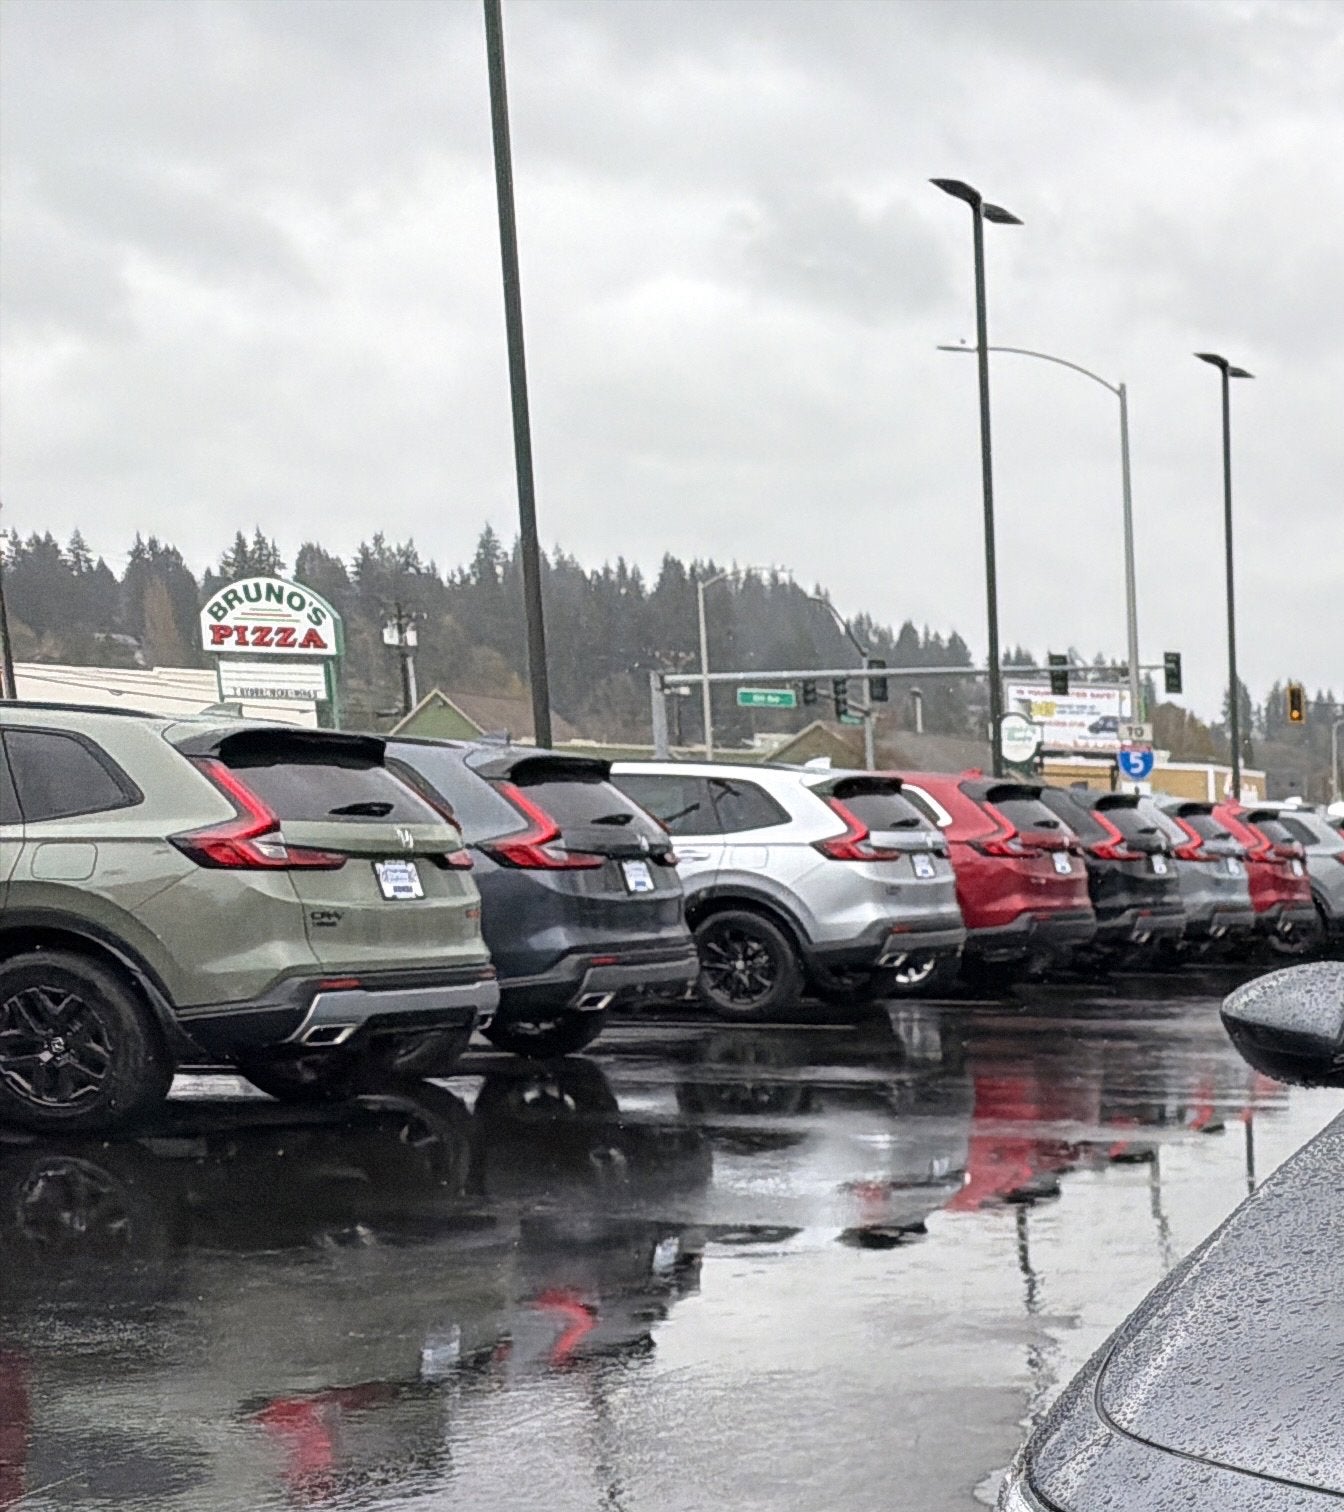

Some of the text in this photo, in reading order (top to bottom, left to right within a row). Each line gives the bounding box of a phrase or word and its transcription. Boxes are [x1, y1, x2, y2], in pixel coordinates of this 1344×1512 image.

[207, 582, 326, 626] BRUNO'S
[209, 624, 328, 649] PIZZA
[1129, 752, 1144, 774] 5
